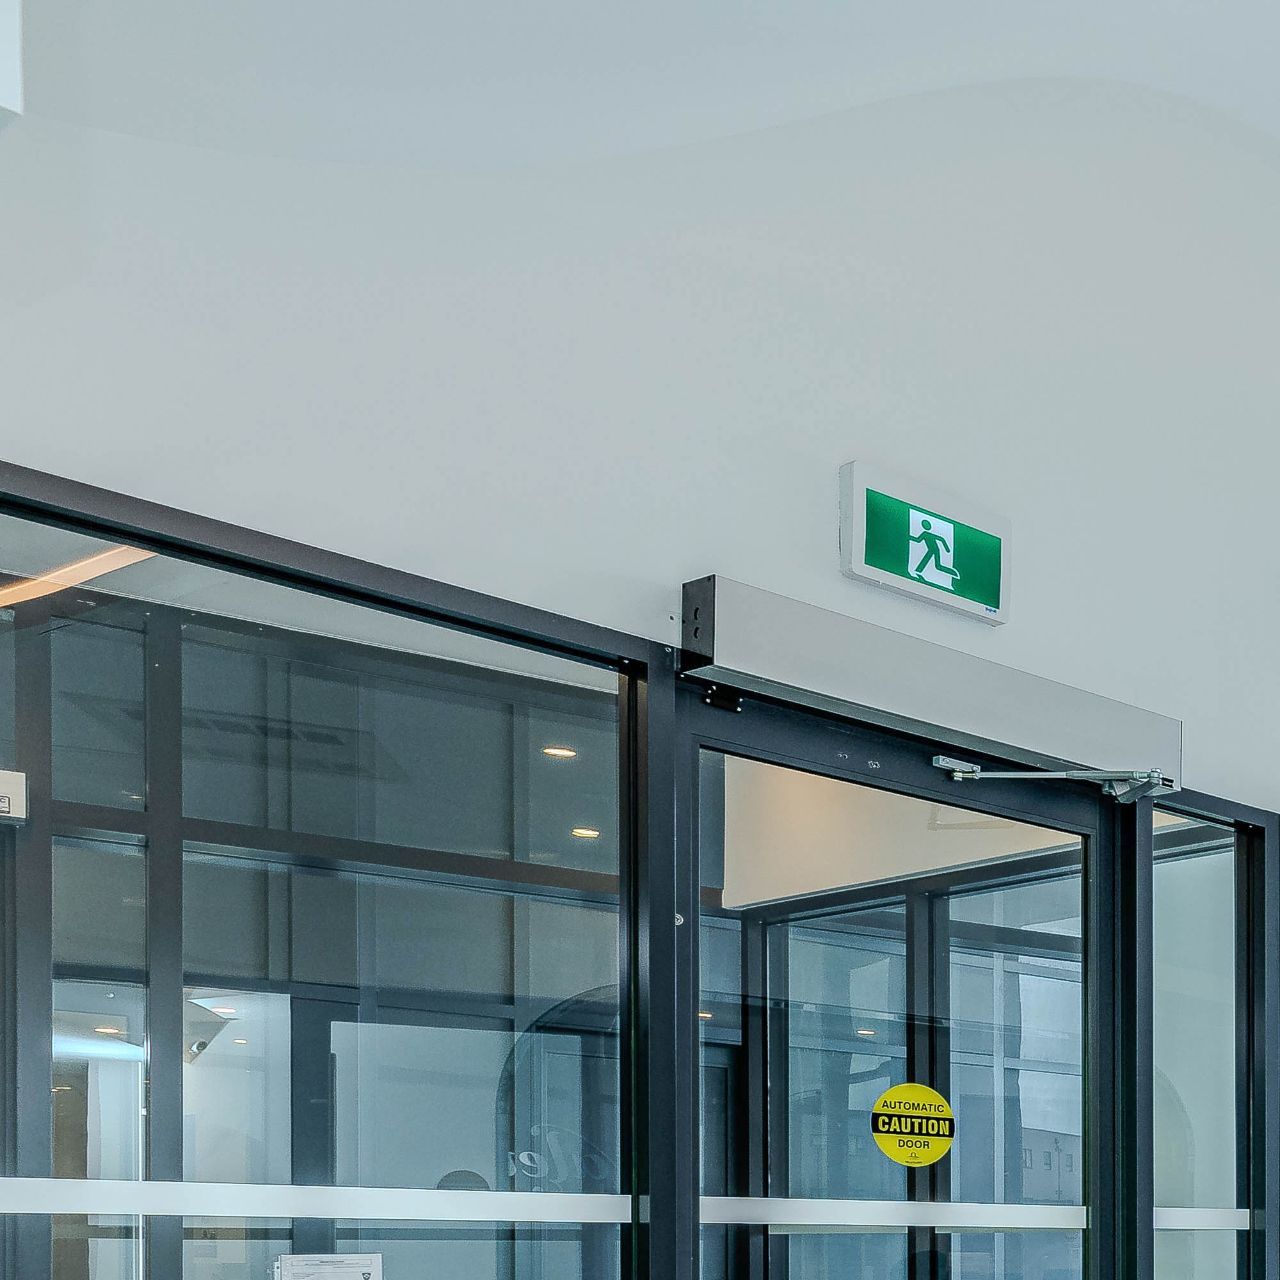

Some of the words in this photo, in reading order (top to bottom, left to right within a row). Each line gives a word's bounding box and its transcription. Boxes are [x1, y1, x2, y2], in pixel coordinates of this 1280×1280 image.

[881, 1100, 945, 1113] AUTOMATIC
[878, 1116, 950, 1135] CAUTION
[898, 1139, 930, 1149] DOOR
